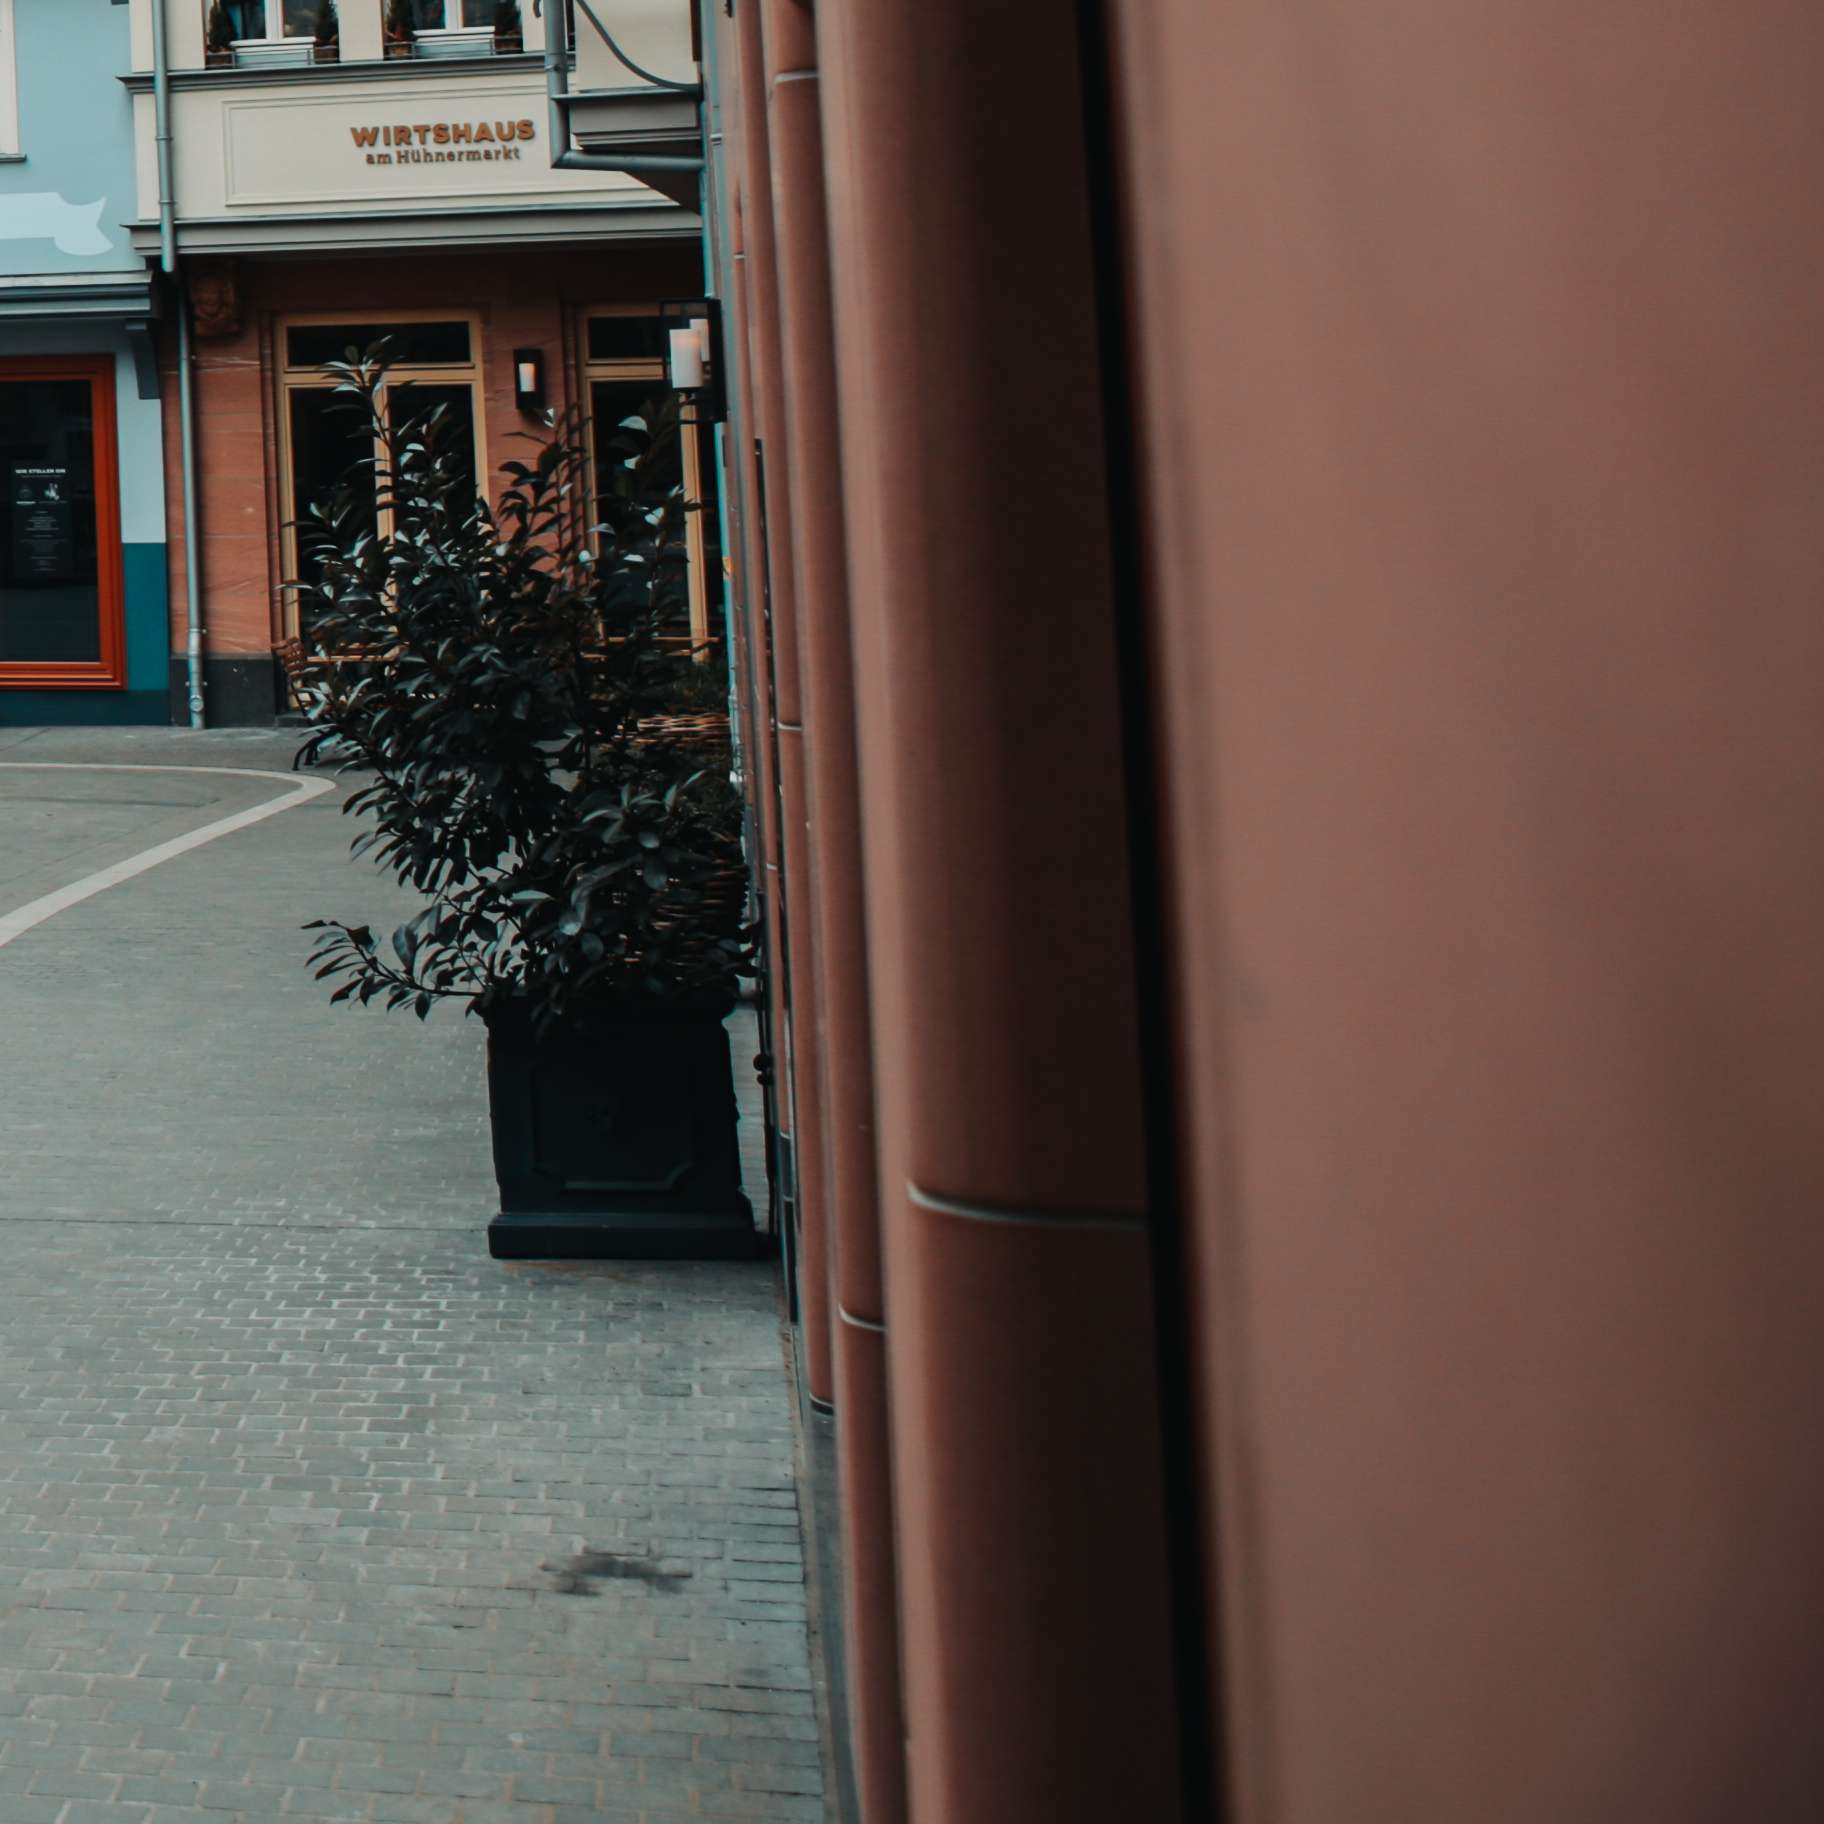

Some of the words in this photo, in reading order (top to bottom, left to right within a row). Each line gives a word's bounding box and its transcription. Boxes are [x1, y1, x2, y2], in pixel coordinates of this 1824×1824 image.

[350, 119, 536, 147] WIRTSHAUS
[366, 151, 392, 164] am
[396, 145, 520, 164] Hühnermarkt
